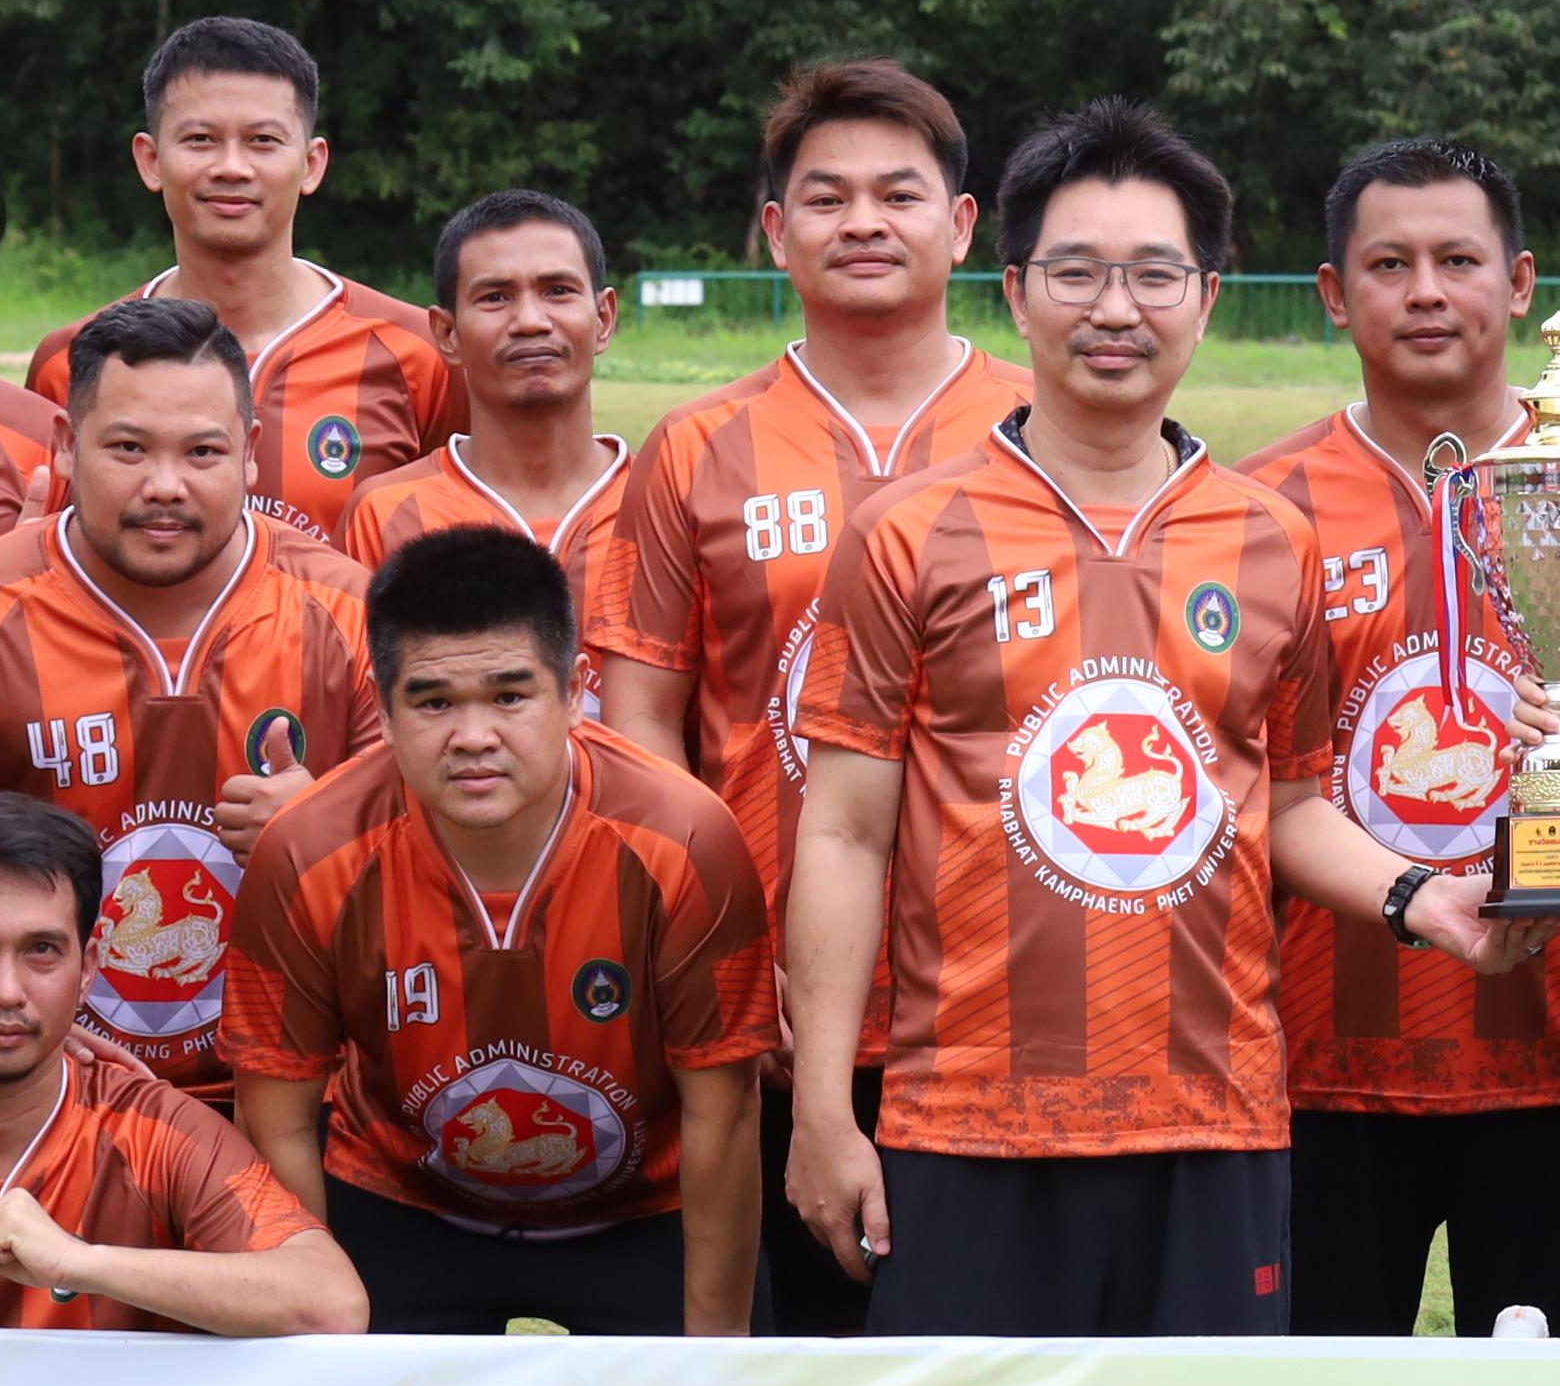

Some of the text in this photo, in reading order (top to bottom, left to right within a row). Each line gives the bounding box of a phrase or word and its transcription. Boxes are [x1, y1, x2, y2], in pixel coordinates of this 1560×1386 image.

[744, 489, 829, 562] 88
[987, 568, 1057, 644] 13
[1323, 547, 1389, 621] 23
[1337, 629, 1522, 731] PUBLIC ADMISTRA
[26, 712, 120, 788] 48
[1007, 682, 1066, 758] PUBLIC
[998, 778, 1039, 865] RAJABHAT
[1034, 867, 1146, 915] KAMPHAENG
[1156, 883, 1196, 912] PHET
[385, 962, 439, 1032] 19
[402, 1039, 637, 1116] PUBLIC ADMINISTRATION
